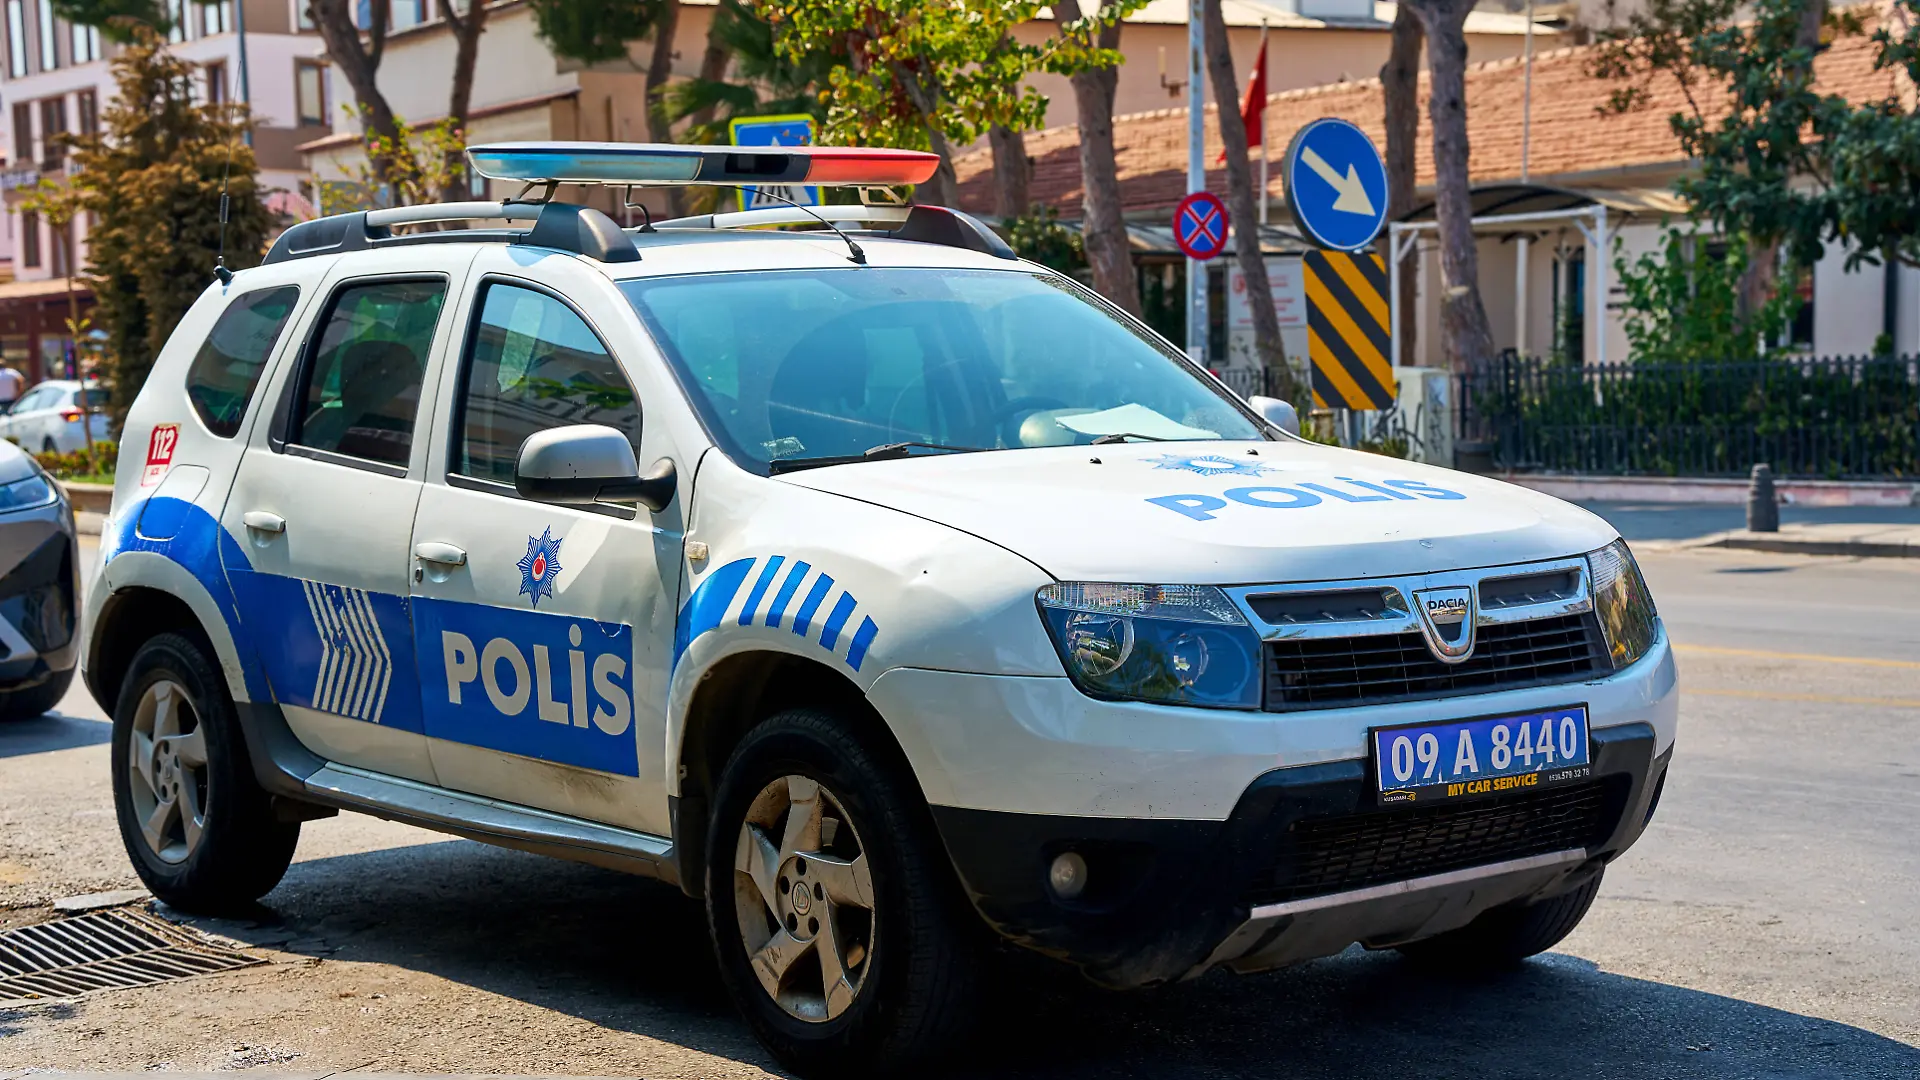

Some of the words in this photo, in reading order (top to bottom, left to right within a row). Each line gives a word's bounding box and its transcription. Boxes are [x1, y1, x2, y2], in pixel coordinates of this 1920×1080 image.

[151, 429, 175, 460] 112
[1143, 476, 1467, 521] POLİS
[1428, 597, 1466, 610] DACIA
[442, 623, 631, 736] POLİS
[1391, 732, 1439, 782] 09
[1453, 729, 1479, 775] A
[1491, 716, 1577, 770] 8440
[1448, 783, 1465, 797] MY
[1467, 779, 1491, 793] CAR
[1573, 768, 1582, 778] 32
[1582, 767, 1590, 776] 78
